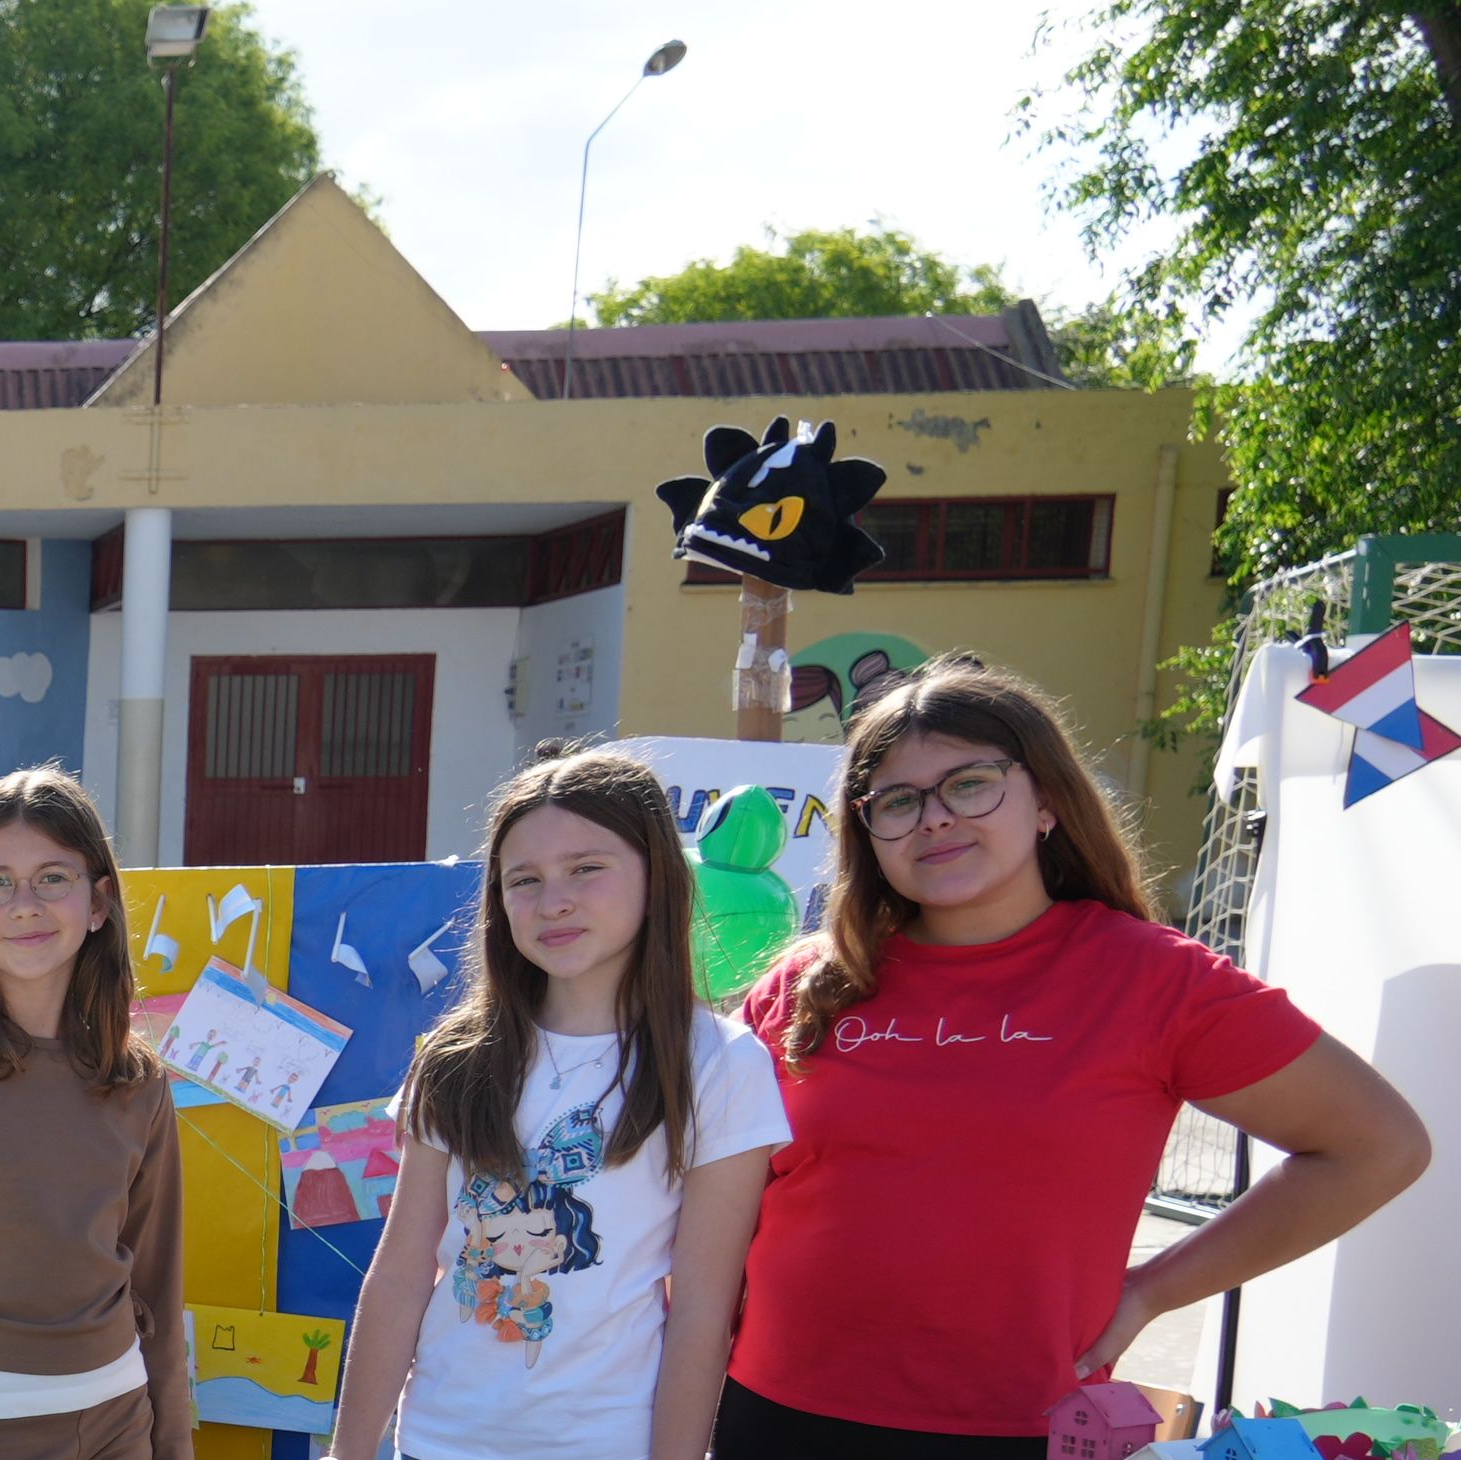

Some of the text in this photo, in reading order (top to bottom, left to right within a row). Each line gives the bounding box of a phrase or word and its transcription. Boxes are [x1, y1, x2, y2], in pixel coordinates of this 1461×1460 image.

[833, 1013, 1054, 1053] Ooh la la
